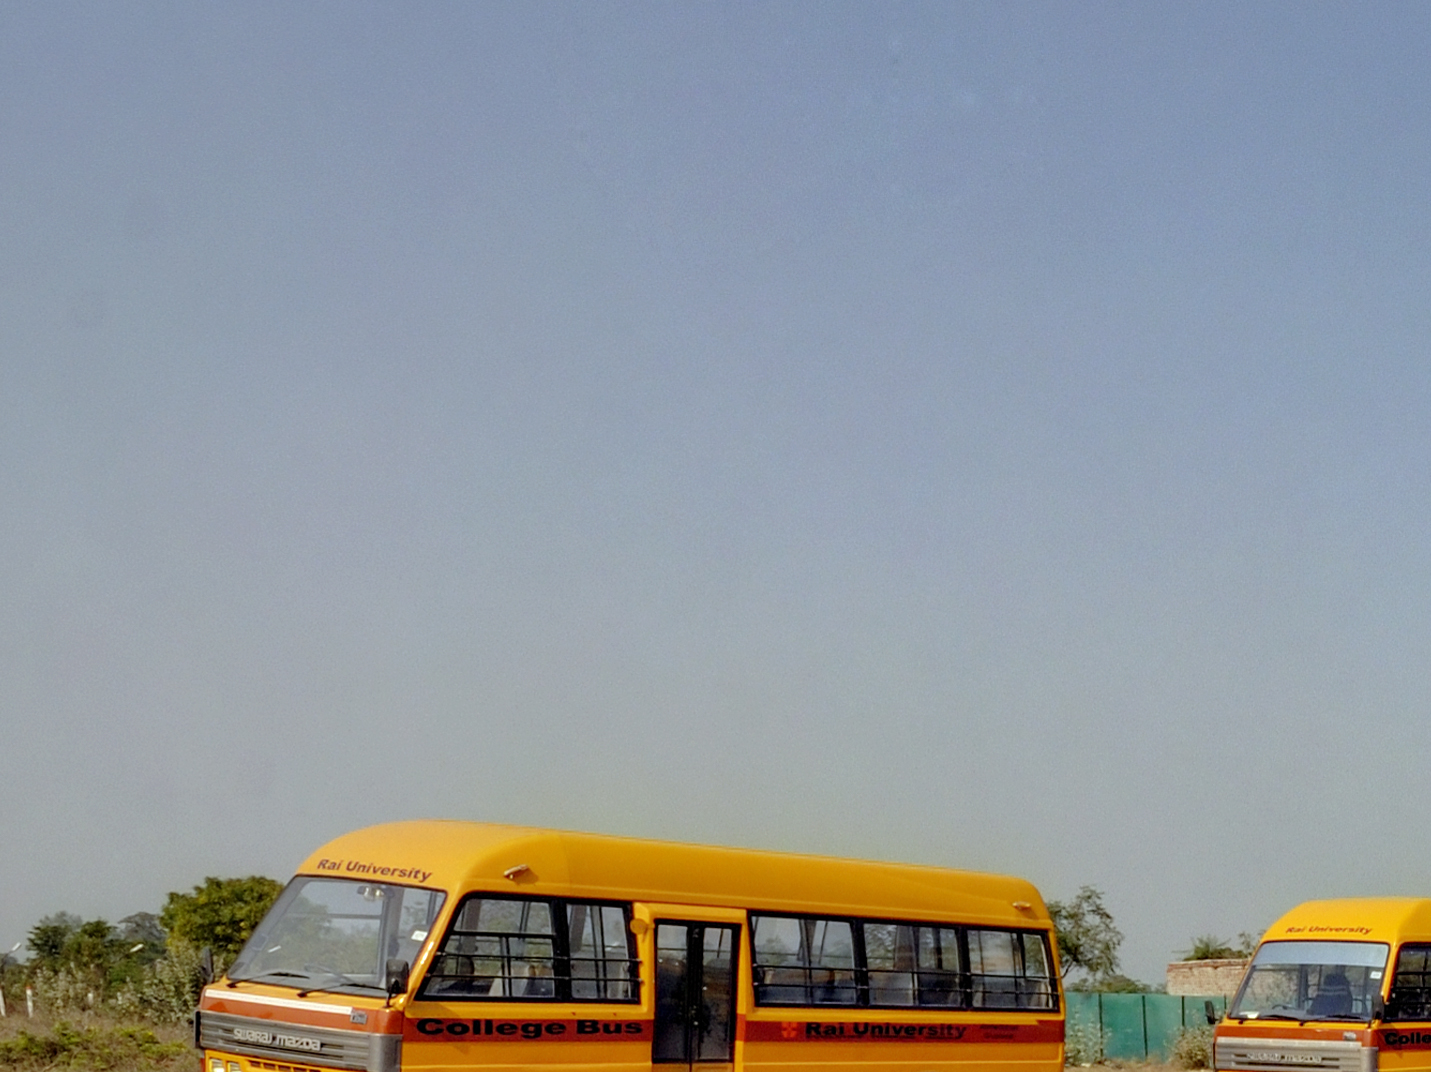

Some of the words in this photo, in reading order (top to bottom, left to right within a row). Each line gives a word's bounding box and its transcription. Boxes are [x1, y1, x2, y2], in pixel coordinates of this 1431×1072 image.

[316, 858, 342, 871] Rai
[346, 860, 432, 882] University
[1308, 926, 1372, 935] University
[416, 1018, 566, 1040] College
[576, 1018, 643, 1036] Bus
[805, 1021, 845, 1037] Rai
[853, 1021, 967, 1040] University
